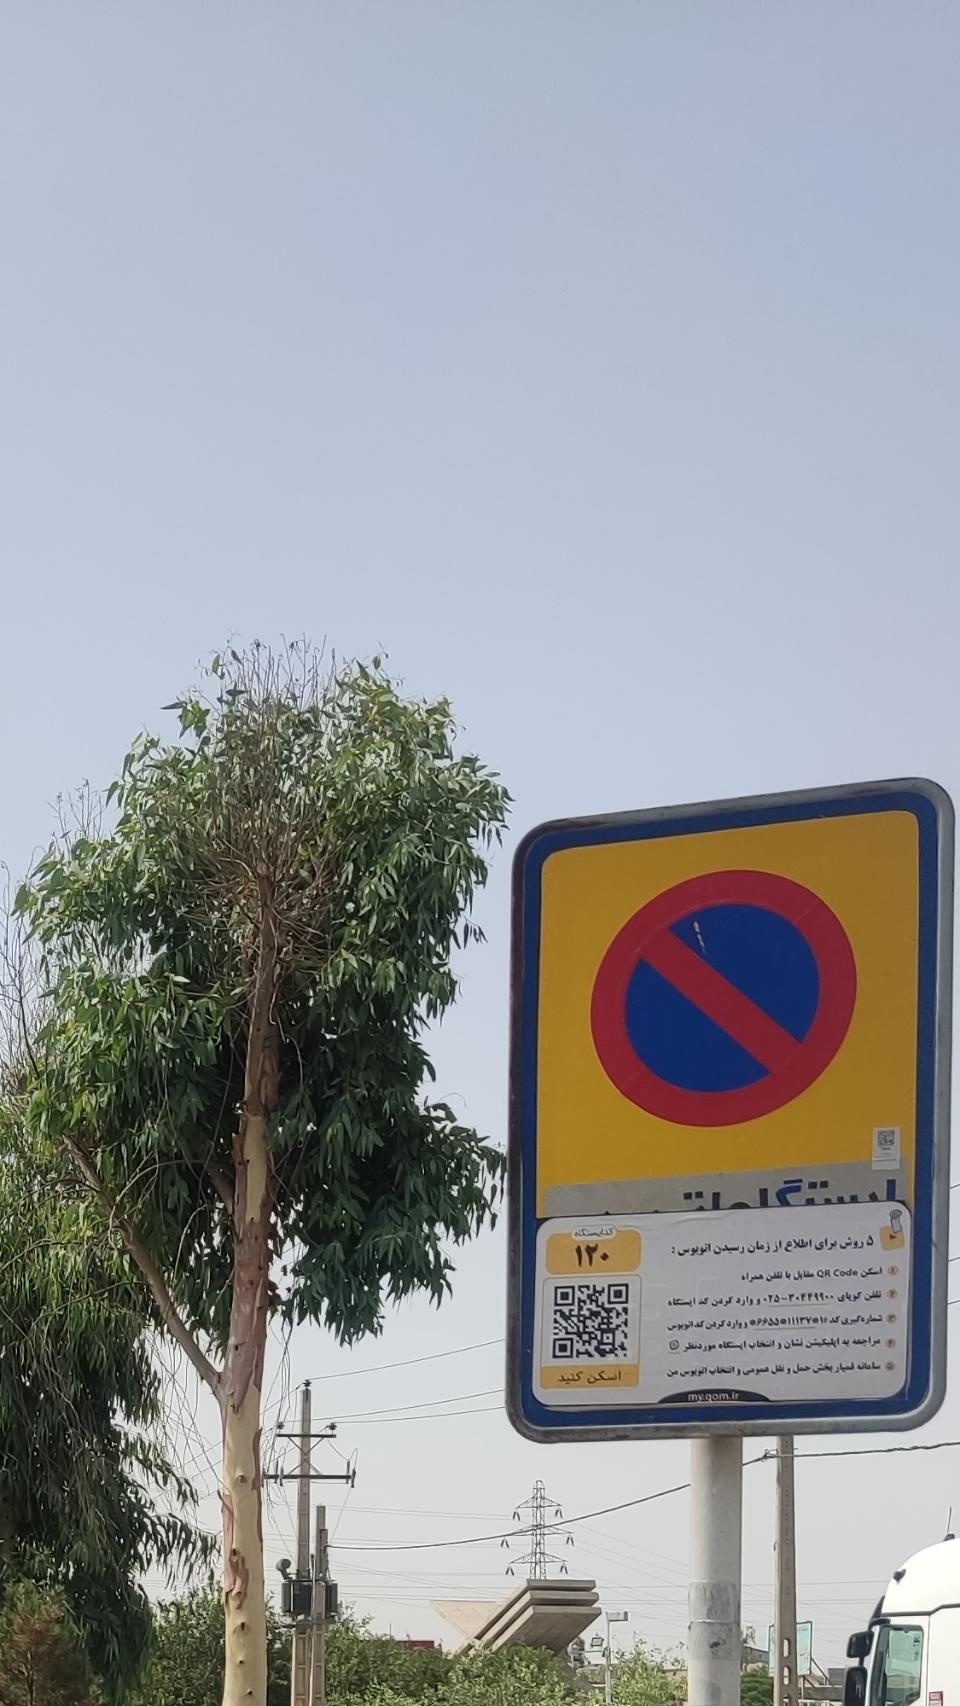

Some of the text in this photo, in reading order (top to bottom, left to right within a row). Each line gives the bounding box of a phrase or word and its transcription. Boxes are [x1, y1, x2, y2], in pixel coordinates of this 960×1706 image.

[785, 1239, 812, 1252] اطلاع
[815, 1238, 837, 1251] برای
[840, 1237, 864, 1249] روش
[866, 1235, 874, 1246] ۵
[678, 1243, 711, 1256] اتوبوس
[713, 1245, 745, 1255] رسیدن
[748, 1241, 771, 1253] زمان
[774, 1240, 782, 1253] از
[575, 1243, 610, 1268] ۱۲۰
[741, 1272, 763, 1283] همراه
[766, 1272, 782, 1282] تلفن
[785, 1271, 791, 1280] با
[793, 1270, 814, 1280] مقابل
[817, 1269, 830, 1278] QR
[834, 1268, 858, 1277] Code
[860, 1267, 882, 1278] اسکن
[698, 1297, 709, 1305] کد
[736, 1296, 753, 1306] وارد
[837, 1291, 862, 1302] گویای
[864, 1291, 882, 1301] تلفن
[668, 1297, 696, 1307] ایستگاه
[712, 1296, 733, 1307] کردن
[667, 1321, 694, 1331] اتوبوس
[695, 1320, 705, 1328] کد
[705, 1320, 725, 1330] کردن
[727, 1320, 742, 1329] وارد
[718, 1341, 746, 1350] ایستگاه
[749, 1339, 775, 1350] انتخاب
[784, 1339, 803, 1349] نشان
[842, 1339, 850, 1347] به
[852, 1336, 881, 1347] مراجعه
[709, 1366, 735, 1375] انتخاب
[771, 1365, 784, 1375] نقل
[857, 1362, 881, 1370] سامانه
[680, 1367, 707, 1377] اتوبوس
[558, 1370, 621, 1385] اسکن کنید
[688, 1391, 739, 1403] my.qom.ir
